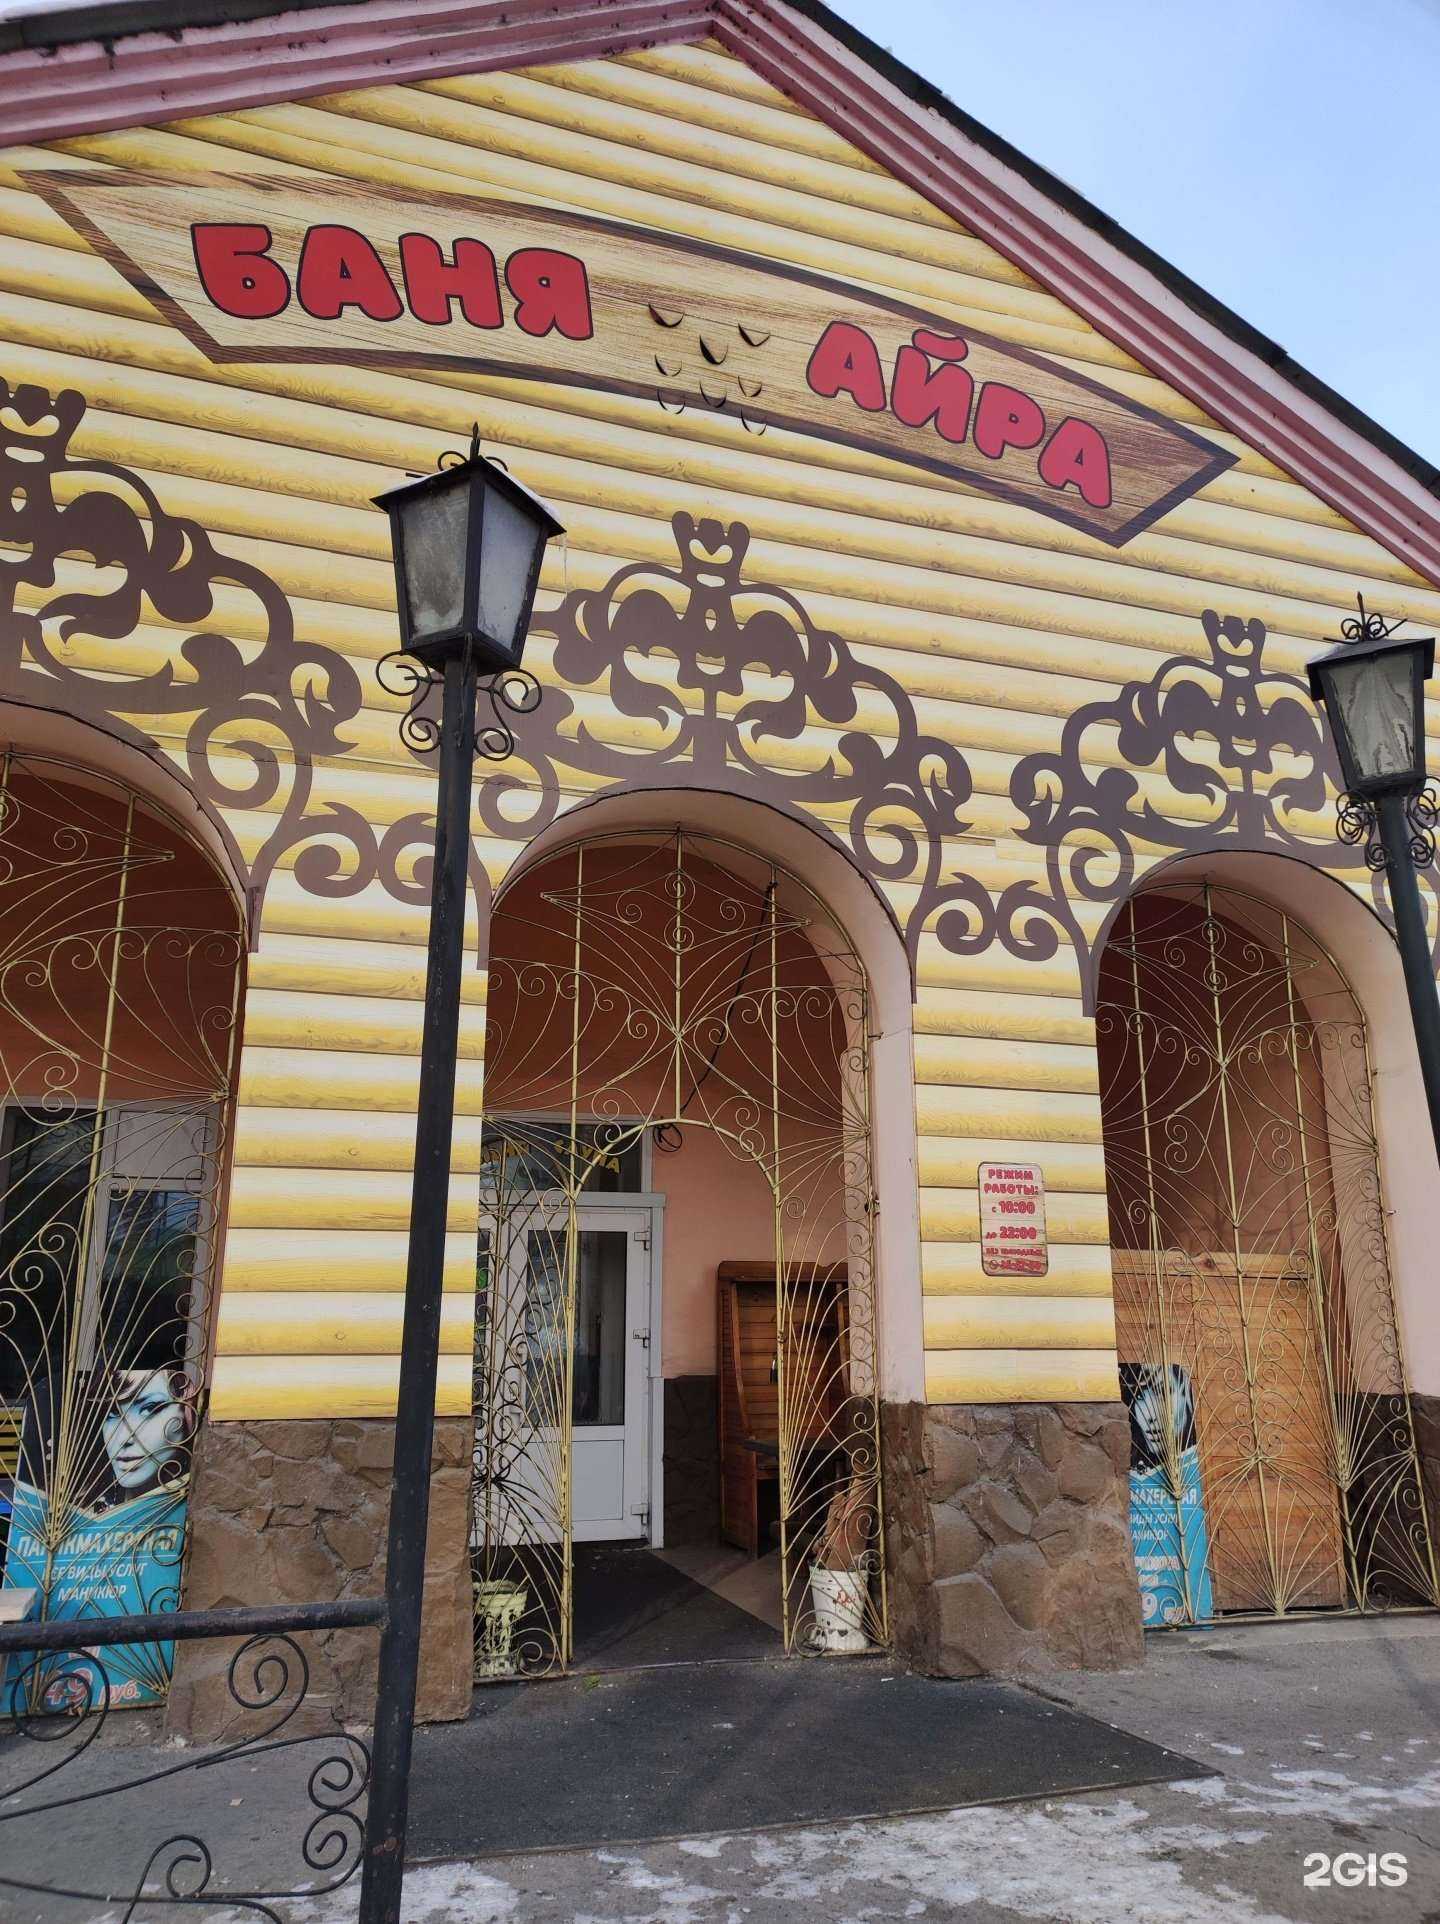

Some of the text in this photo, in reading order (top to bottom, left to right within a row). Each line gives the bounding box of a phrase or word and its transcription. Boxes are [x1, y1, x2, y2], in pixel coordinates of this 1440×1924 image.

[191, 223, 594, 341] БАНЯ
[806, 321, 1112, 509] АЙРА
[988, 1168, 1033, 1180] РЕЖИМ
[984, 1183, 1039, 1195] РАБОТЫ:
[998, 1200, 1036, 1214] 10:00
[999, 1226, 1037, 1240] 22:00
